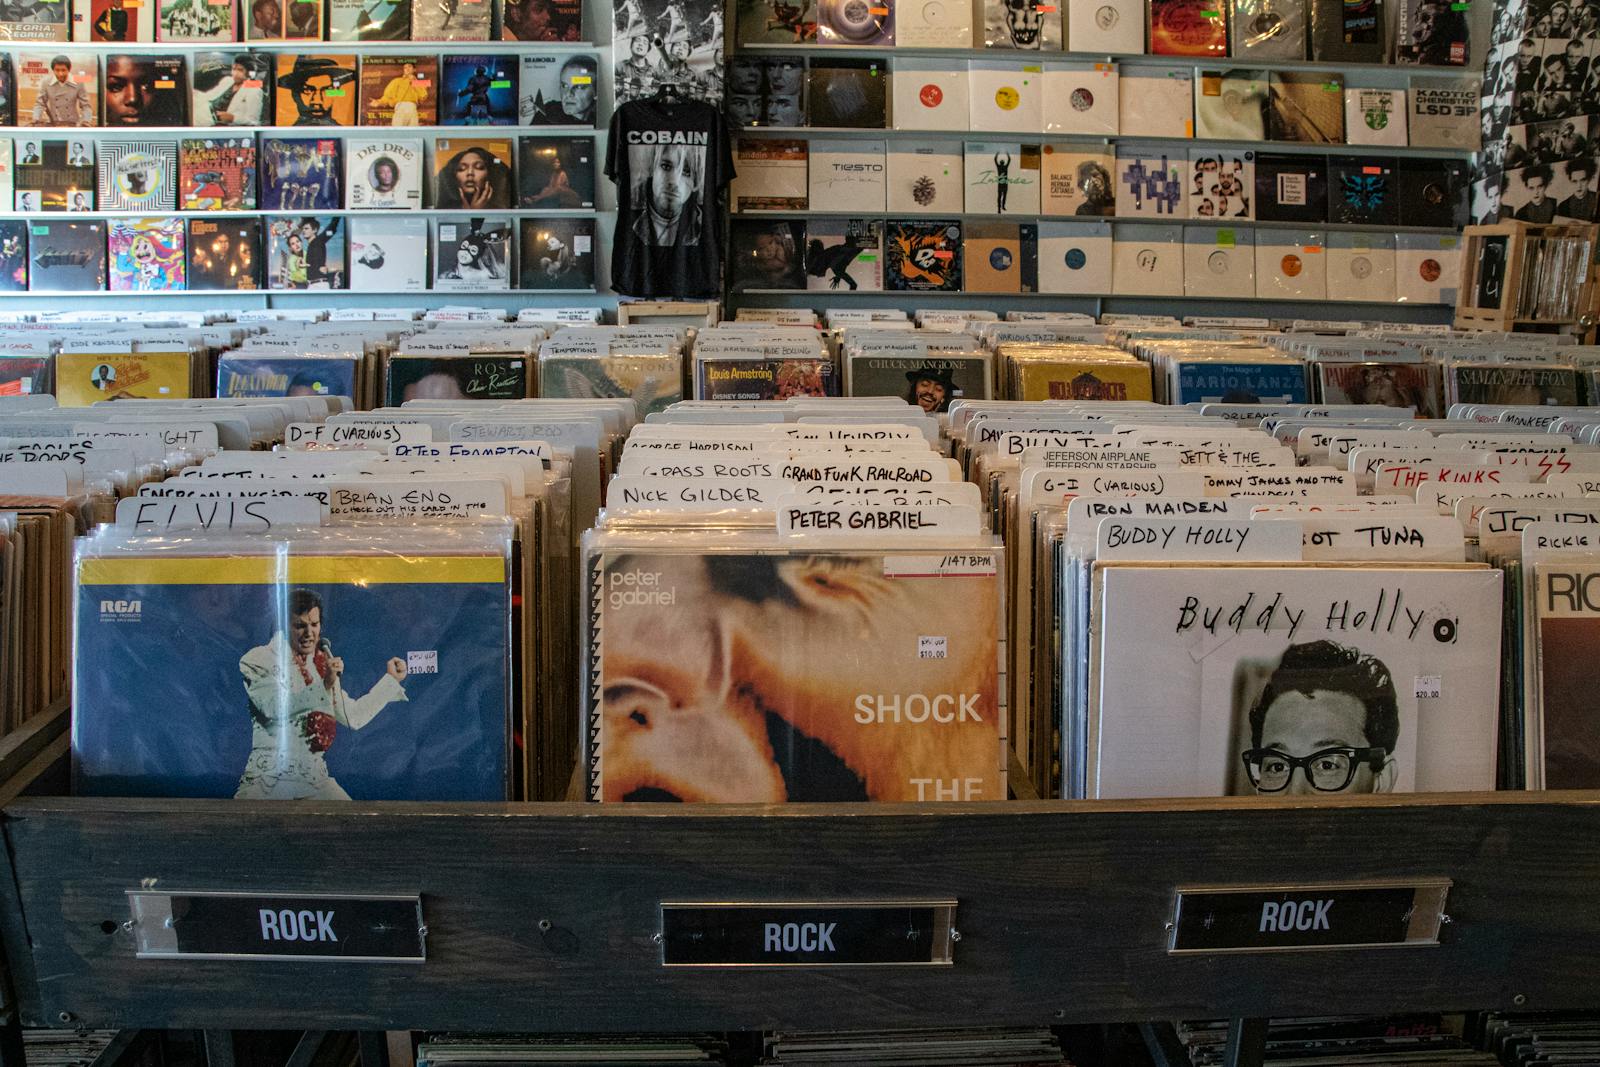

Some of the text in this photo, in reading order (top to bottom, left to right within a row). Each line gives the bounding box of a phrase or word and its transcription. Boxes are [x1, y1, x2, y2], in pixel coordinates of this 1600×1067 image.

[1416, 89, 1477, 98] KAOTIC
[1416, 97, 1476, 105] CHEMISTRY
[1415, 104, 1452, 115] LSD
[627, 130, 708, 145] COBAIN
[356, 143, 415, 161] DR. DRE
[868, 360, 967, 370] CHUCK MANGIONE
[708, 367, 773, 382] Louis Armstrong
[1181, 376, 1305, 389] MARIO LANZA
[1460, 370, 1567, 385] SAMANTHA FOX
[291, 425, 402, 444] D-F (VARIOUS)
[1043, 451, 1151, 462] JEFERSON AIRPLANE
[1180, 449, 1215, 465] JETT
[1233, 451, 1261, 465] THE
[713, 464, 773, 478] ROOTS
[782, 465, 933, 482] GRAND FUNK RAILROAD
[1093, 475, 1165, 496] (VARIOUS)
[1204, 475, 1345, 487] TOMMY JAMES AND THE
[335, 489, 452, 506] BRIAN ENO
[623, 487, 764, 504] NICK GILDER
[376, 505, 395, 514] OUT
[421, 505, 446, 513] CARD
[450, 503, 460, 511] IN
[1087, 499, 1229, 519] IRON MAIDEN
[132, 501, 272, 535] ELVIS
[789, 509, 938, 530] PETER GABRIEL
[1107, 524, 1250, 553] BUDDY HOLLY
[1302, 525, 1424, 549] OT TUNA
[1537, 536, 1589, 549] RICKIE
[969, 556, 991, 567] BPM
[610, 568, 663, 591] peter
[609, 585, 676, 610] gabriel
[100, 600, 142, 613] RCA
[1176, 587, 1425, 640] Buddy Holly
[920, 650, 945, 659] $10.00
[409, 665, 436, 674] $10.00
[1415, 690, 1440, 699] $20.00
[854, 693, 984, 725] SHOCK
[910, 777, 985, 801] THE
[1259, 898, 1335, 933] ROCK
[259, 908, 339, 942] ROCK
[764, 921, 838, 953] ROCK
